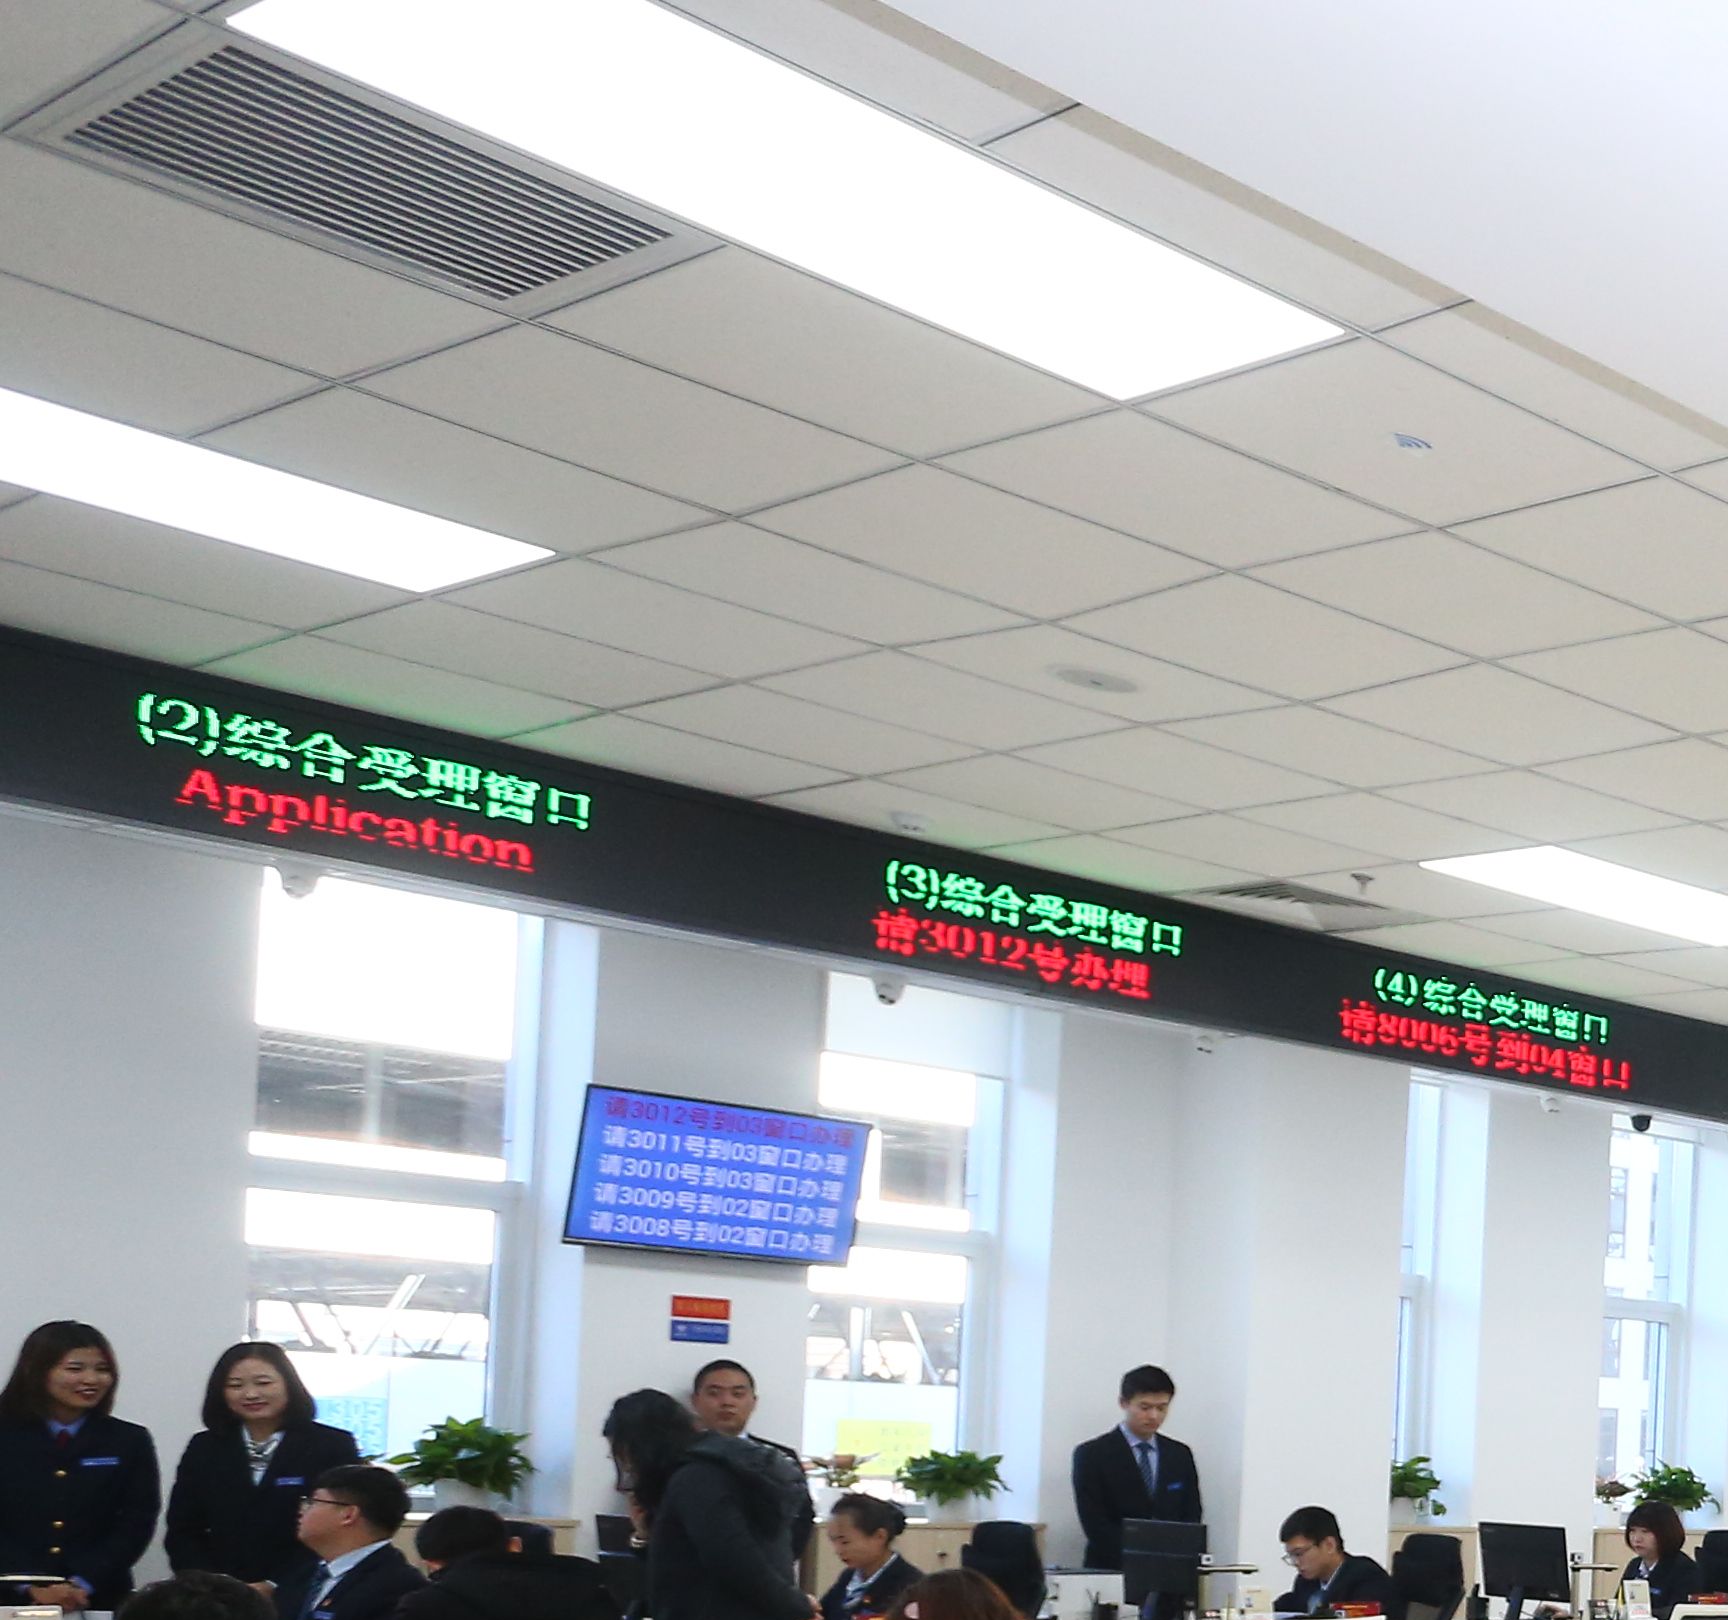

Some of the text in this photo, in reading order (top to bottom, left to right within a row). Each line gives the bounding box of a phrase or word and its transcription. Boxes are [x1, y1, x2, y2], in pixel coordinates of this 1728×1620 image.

[137, 693, 591, 830] (2)综合受理窗口
[176, 768, 535, 873] Application
[886, 860, 1183, 956] (3)综合受理窗口
[871, 907, 1152, 1000] 请3012号办理
[605, 1095, 855, 1149] 请3012号到03窗口办理
[599, 1152, 845, 1201] 请3010号到03窗口办理
[602, 1124, 848, 1176] 请3011号到03窗口办理
[594, 1182, 839, 1229] 请3009号到02窗口办理
[589, 1210, 835, 1256] 请3008号到02窗口办理
